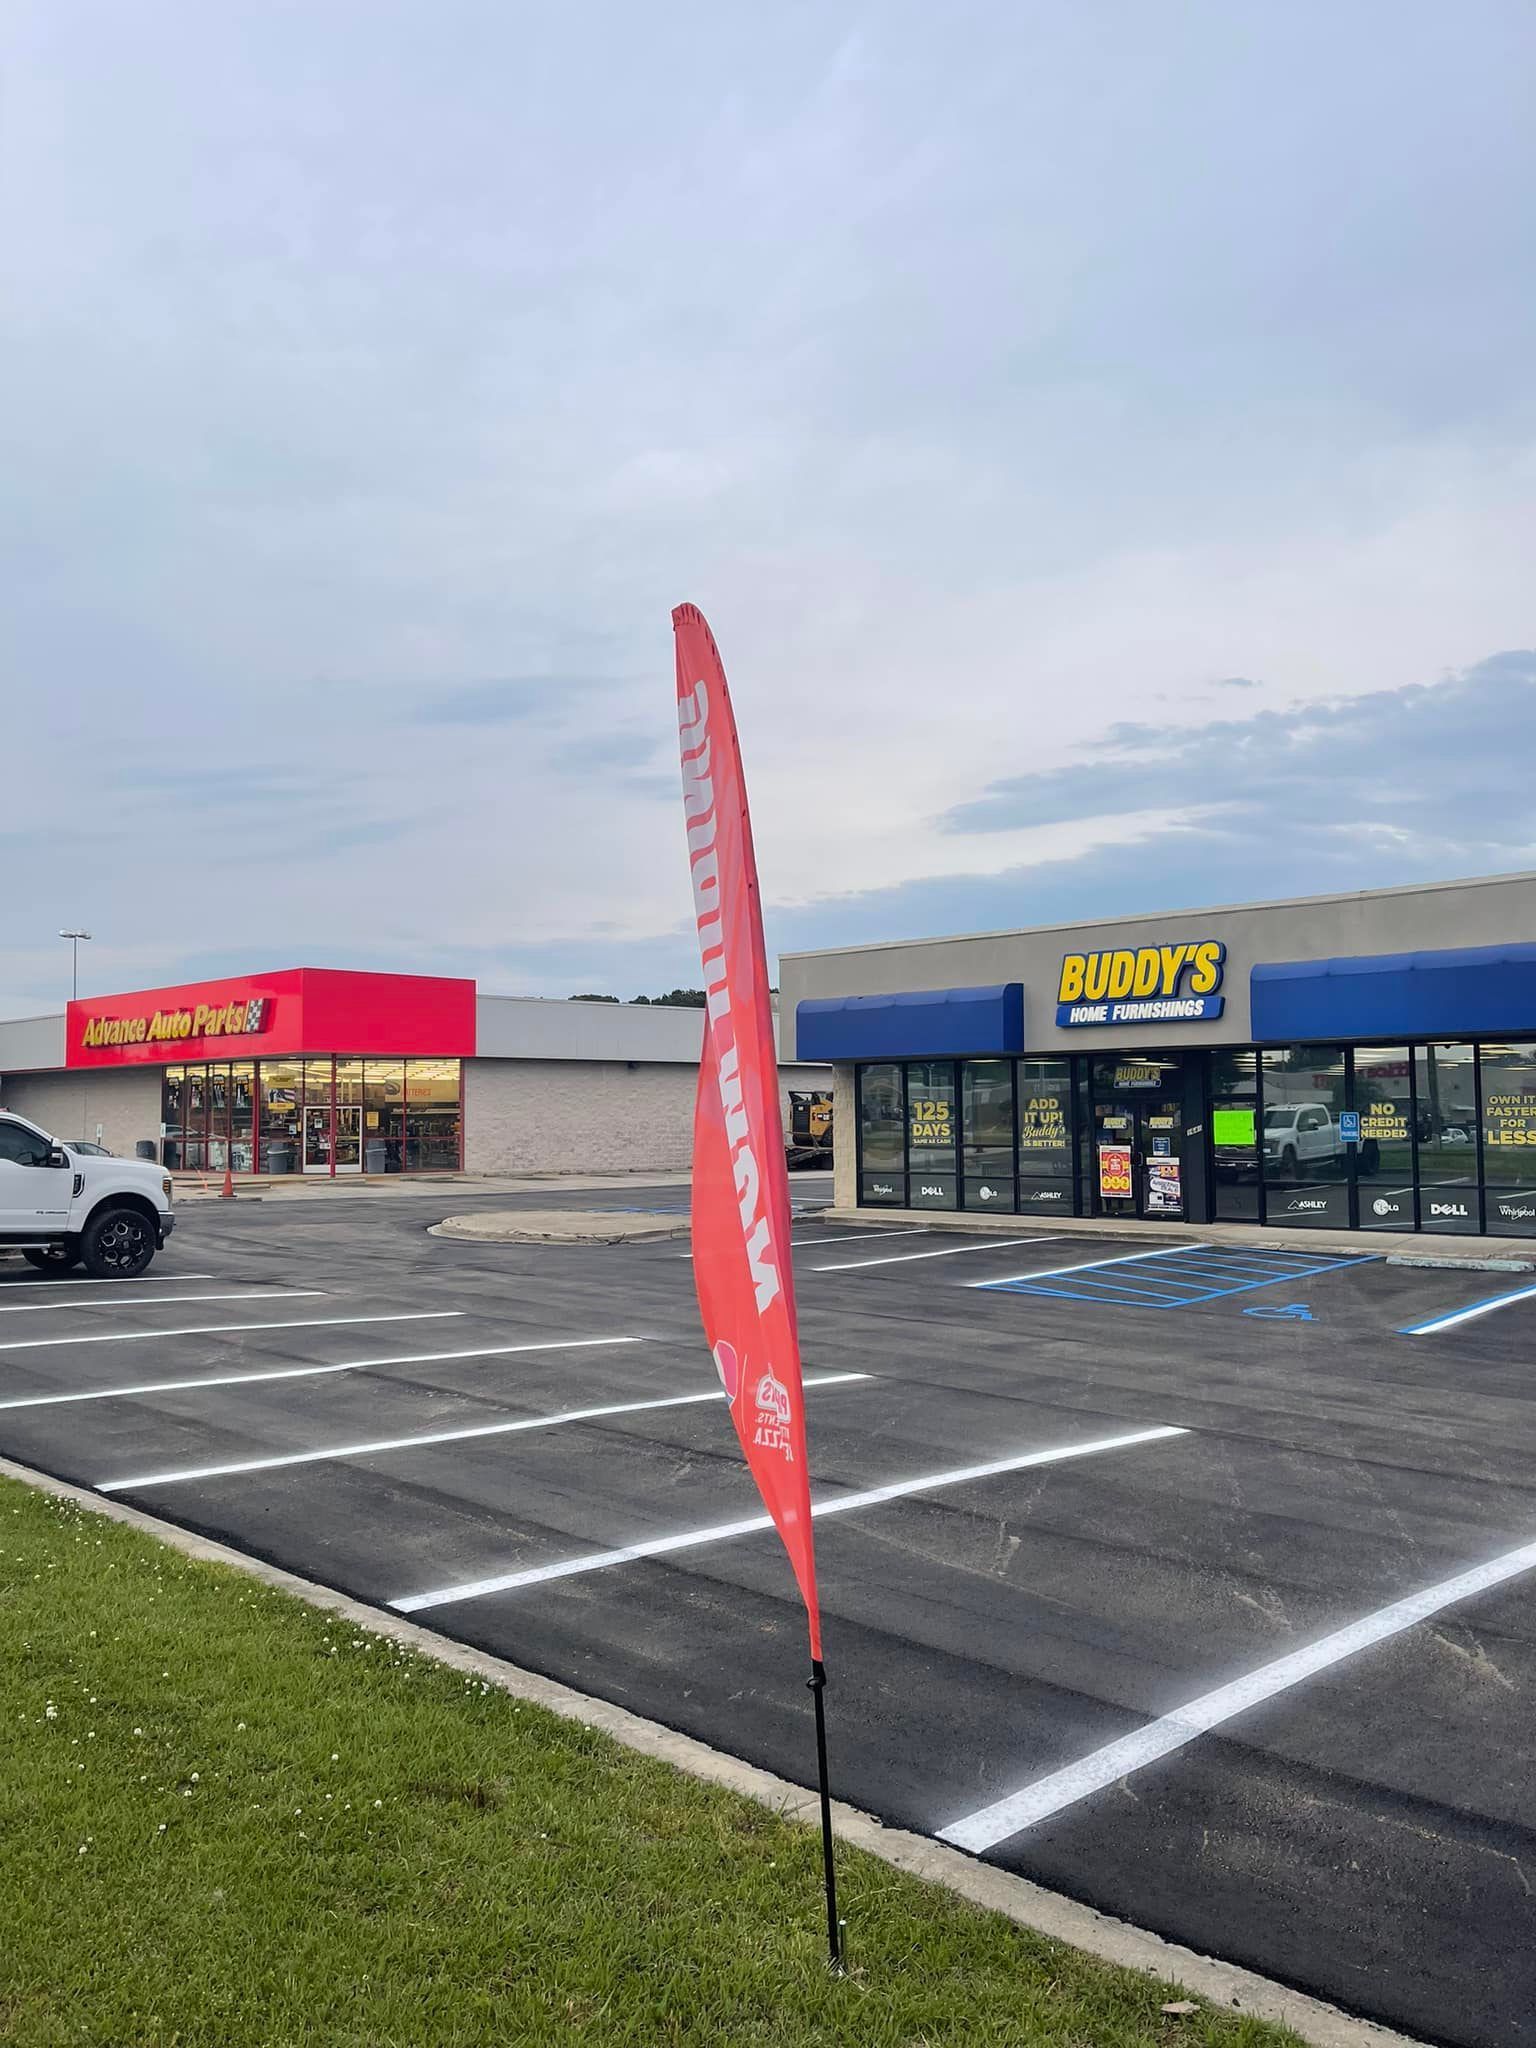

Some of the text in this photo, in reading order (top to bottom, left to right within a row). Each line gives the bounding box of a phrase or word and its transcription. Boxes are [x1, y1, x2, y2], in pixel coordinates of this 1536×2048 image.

[1058, 942, 1220, 1003] BUDDY'S
[1069, 1000, 1204, 1023] HOME FURNISHINGS
[82, 1001, 247, 1047] Advance Auto Parts
[1029, 1098, 1059, 1110] ADD
[1489, 1096, 1536, 1105] OWN IT
[913, 1101, 949, 1121] 125
[1370, 1103, 1395, 1115] NO
[1487, 1107, 1536, 1116] FASTER
[1024, 1112, 1064, 1124] IT UP!
[1360, 1117, 1407, 1128] CREDIT
[1500, 1119, 1525, 1128] FOR
[912, 1123, 951, 1137] DAYS
[1023, 1124, 1065, 1139] Buddy's
[1360, 1129, 1408, 1138] NEEDED
[1487, 1130, 1536, 1145] LESS
[921, 1186, 944, 1196] DELL
[1299, 1200, 1327, 1209] ASHLEY
[1430, 1203, 1468, 1216] DELL
[1499, 1204, 1536, 1220] Whirlpool
